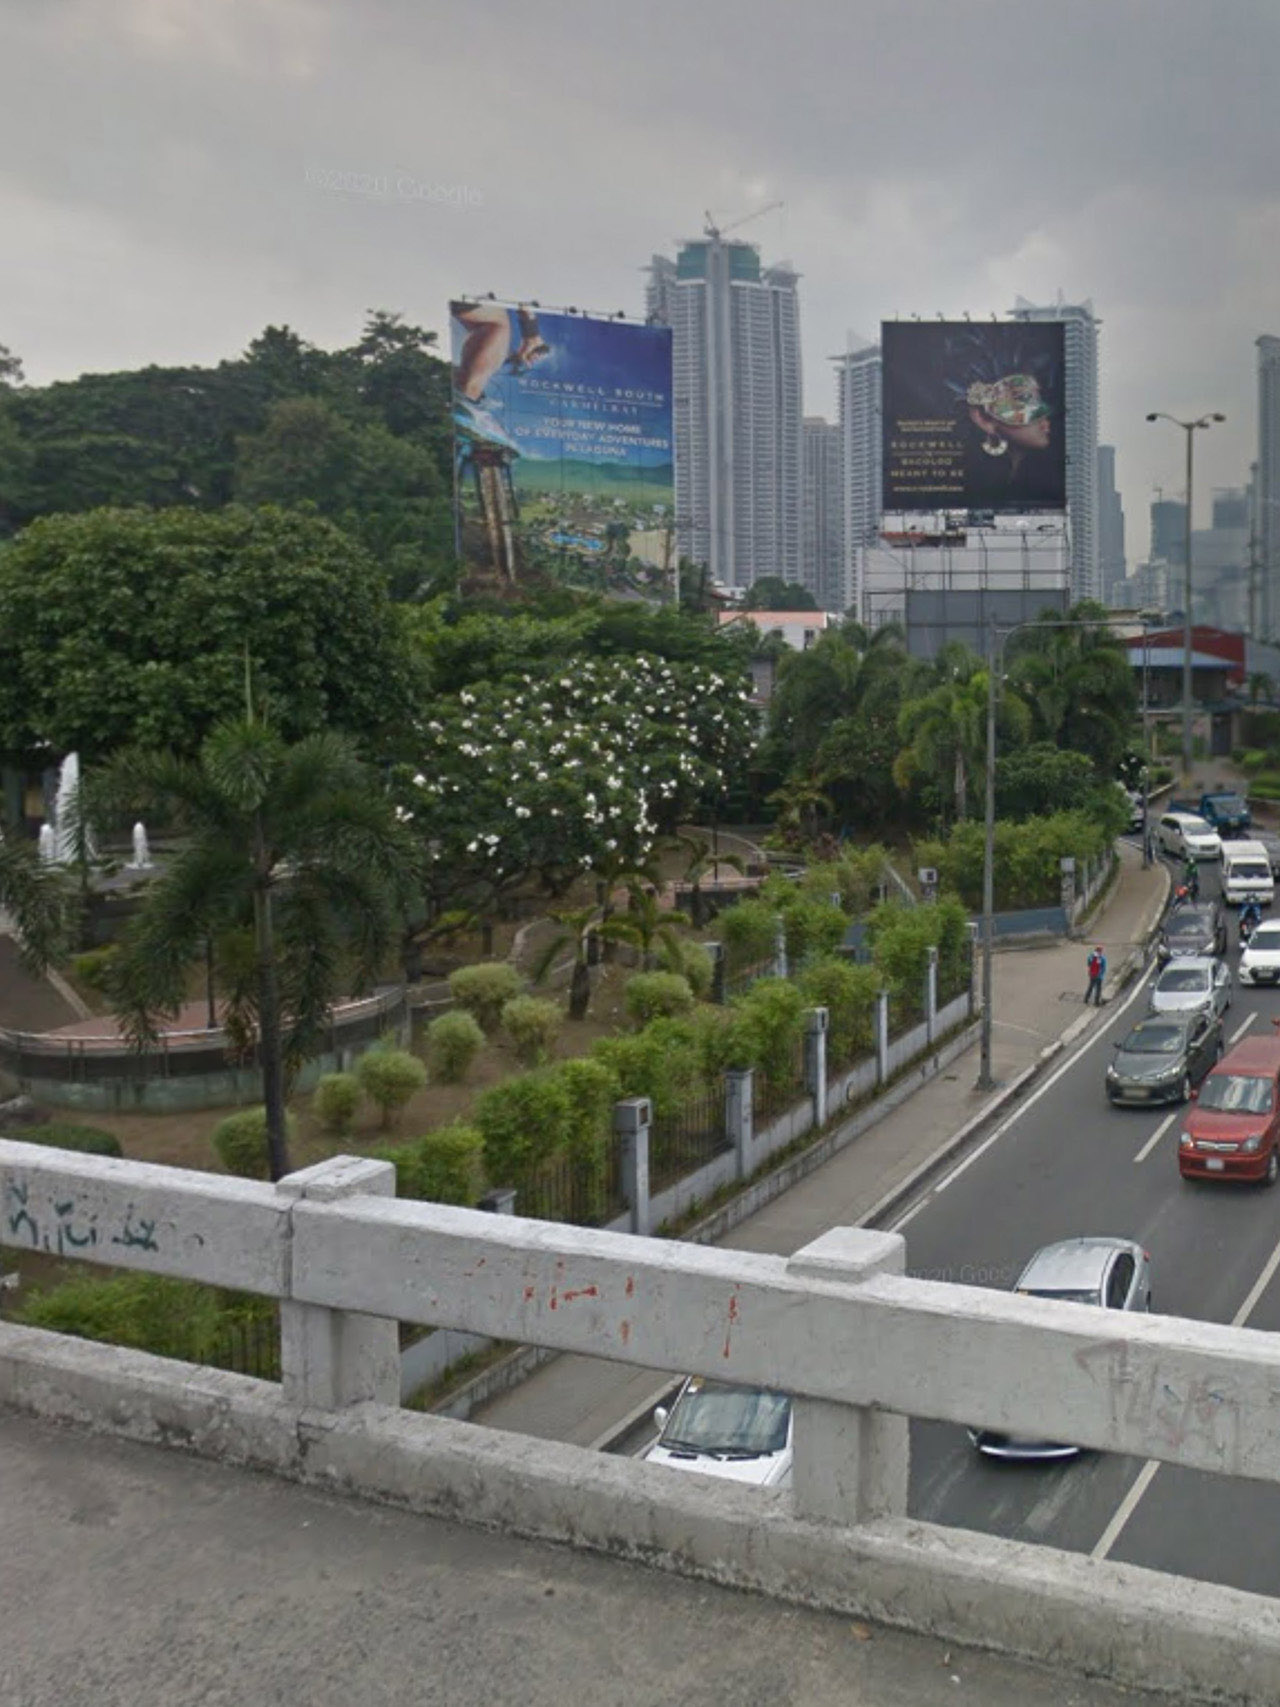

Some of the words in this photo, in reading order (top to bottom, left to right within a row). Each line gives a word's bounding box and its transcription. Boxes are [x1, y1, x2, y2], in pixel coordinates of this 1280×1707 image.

[518, 378, 605, 396] ROCKWELL
[615, 388, 665, 401] SOUTH
[578, 419, 606, 431] NEW
[607, 422, 642, 435] HOME
[598, 434, 669, 450] ADVENTURES
